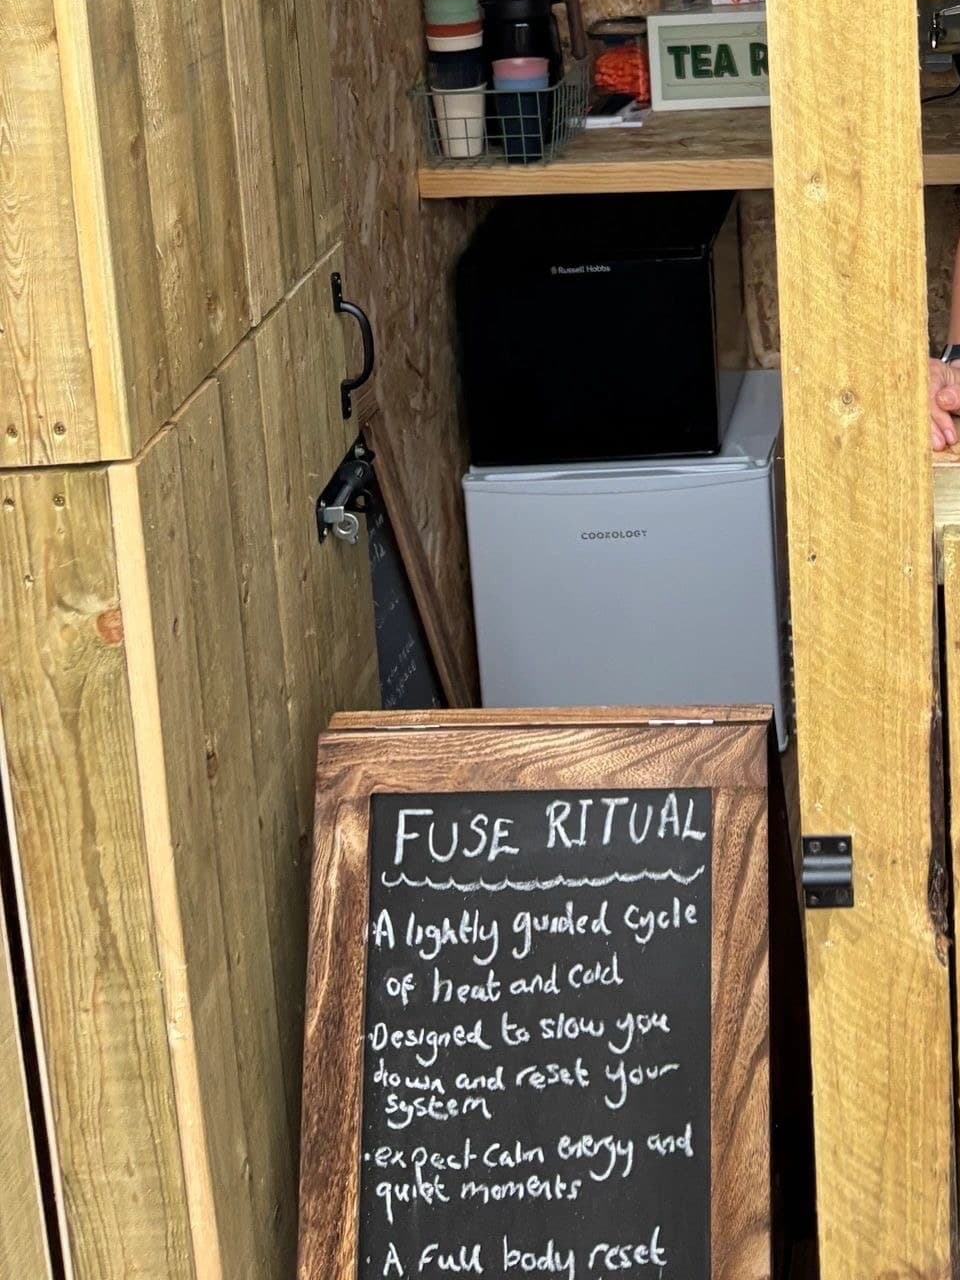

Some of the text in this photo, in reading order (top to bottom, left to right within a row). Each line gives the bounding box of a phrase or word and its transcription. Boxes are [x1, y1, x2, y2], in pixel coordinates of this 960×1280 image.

[666, 43, 740, 80] TEA
[586, 264, 611, 273] Hobbs
[393, 791, 707, 866] FUSE RITUAL
[374, 909, 395, 949] A
[405, 908, 500, 966] lightly
[511, 900, 613, 960] guided
[386, 972, 416, 1006] of
[431, 966, 502, 1004] heat
[509, 962, 561, 995] and
[371, 1010, 672, 1068] Designed to slow you
[455, 1065, 507, 1091] and
[515, 1057, 590, 1091] reset
[604, 1059, 682, 1110] your
[384, 1093, 493, 1130] system
[556, 1134, 634, 1182] energy
[647, 1122, 694, 1157] and
[460, 1173, 583, 1205] moments
[382, 1241, 405, 1277] A
[503, 1233, 576, 1280] body
[587, 1225, 668, 1271] reset
